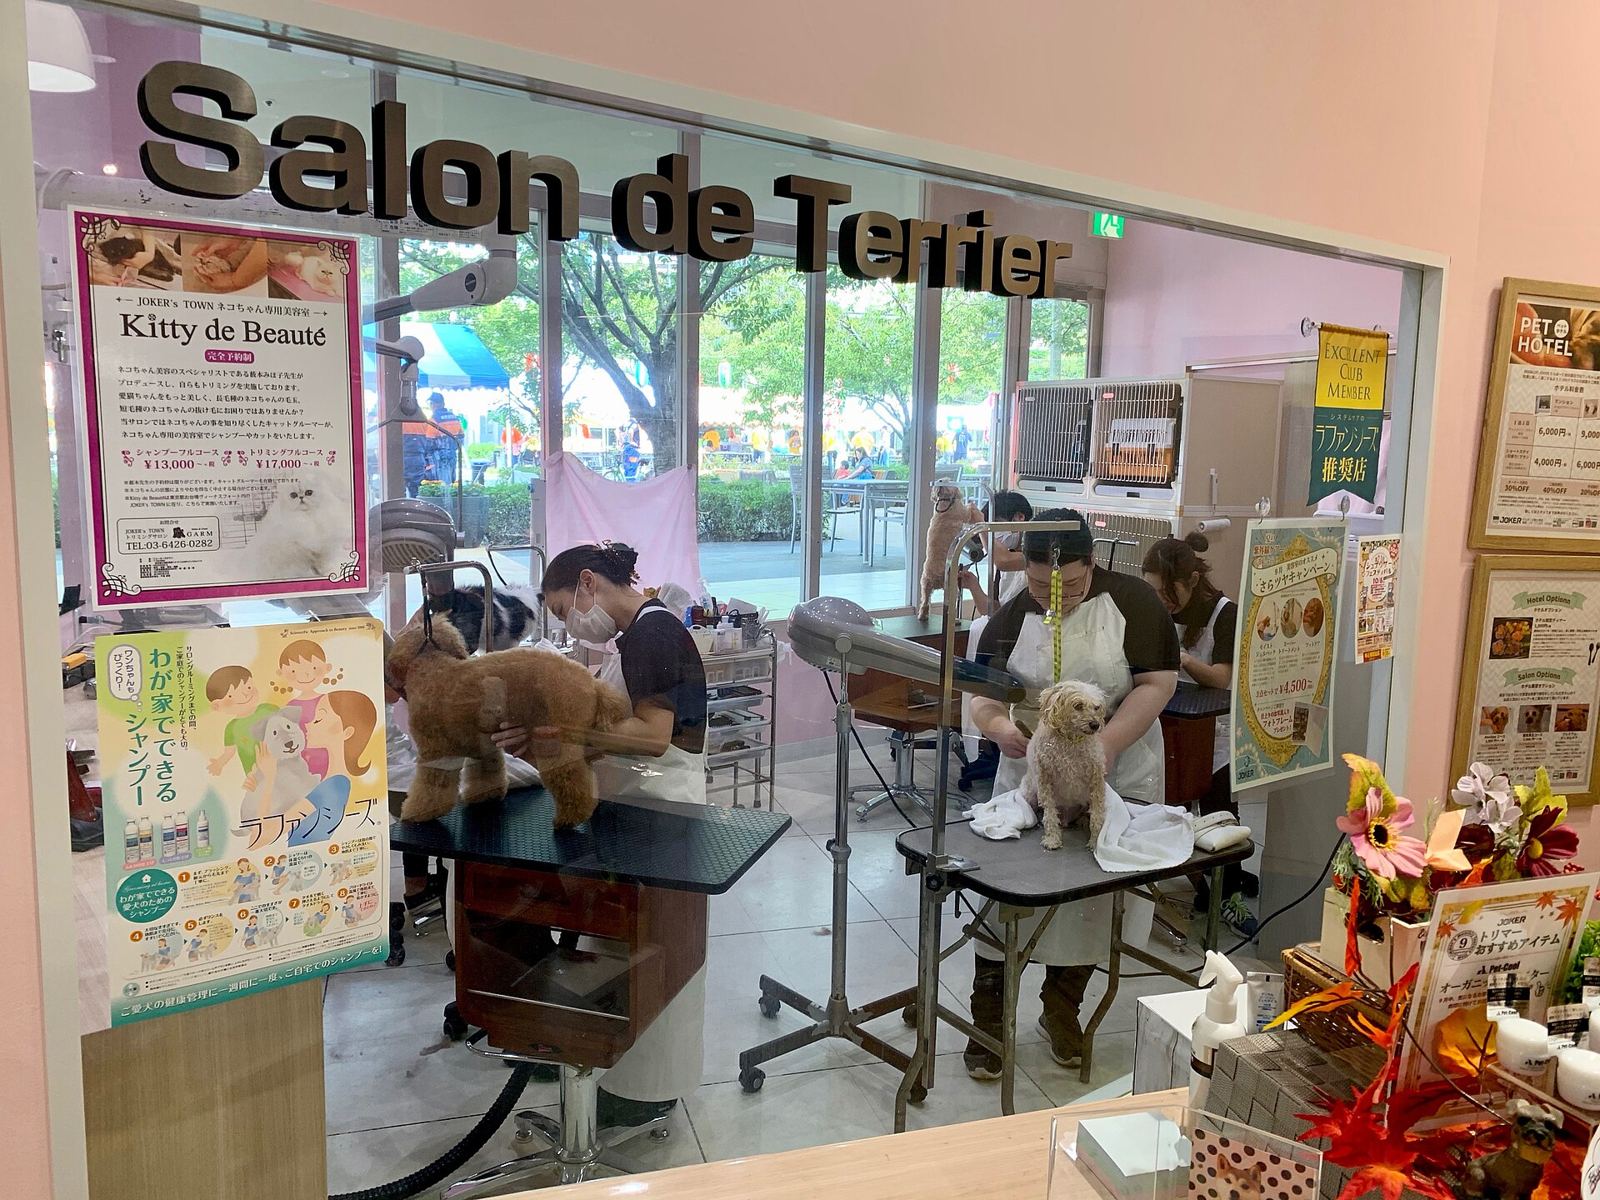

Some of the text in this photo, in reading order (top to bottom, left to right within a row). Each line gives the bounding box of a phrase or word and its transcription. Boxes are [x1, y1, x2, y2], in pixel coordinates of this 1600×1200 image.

[137, 60, 1073, 299] Salon de Terrier
[137, 296, 310, 318] JOKER's TOWN ネコちゃん専用美容室
[119, 313, 326, 346] Kitty de Beauté
[1520, 316, 1553, 336] PET
[1517, 335, 1573, 357] HOTEL
[207, 351, 252, 362] 完全予約制
[1315, 425, 1379, 452] ラファンシーズ
[1538, 427, 1566, 437] 6,000円
[136, 448, 323, 456] シャンプーフルコース トリミングフルコース
[1322, 456, 1367, 483] 推奨店
[1534, 458, 1562, 467] 4,000円
[1500, 516, 1522, 524] JOKER
[1526, 595, 1545, 605] Hotel
[124, 650, 135, 693] ワンちゃんも
[1518, 671, 1561, 681] Salon Options
[149, 648, 177, 803] わが家でできる
[126, 713, 151, 806] シャンプー
[239, 798, 378, 849] ラファンシーズ
[120, 887, 176, 904] わが家でできる
[1497, 915, 1527, 927] JOKER
[1475, 933, 1560, 956] おすすめアイテム
[1481, 928, 1522, 943] トリマー
[1489, 961, 1521, 974] Pet-Cool
